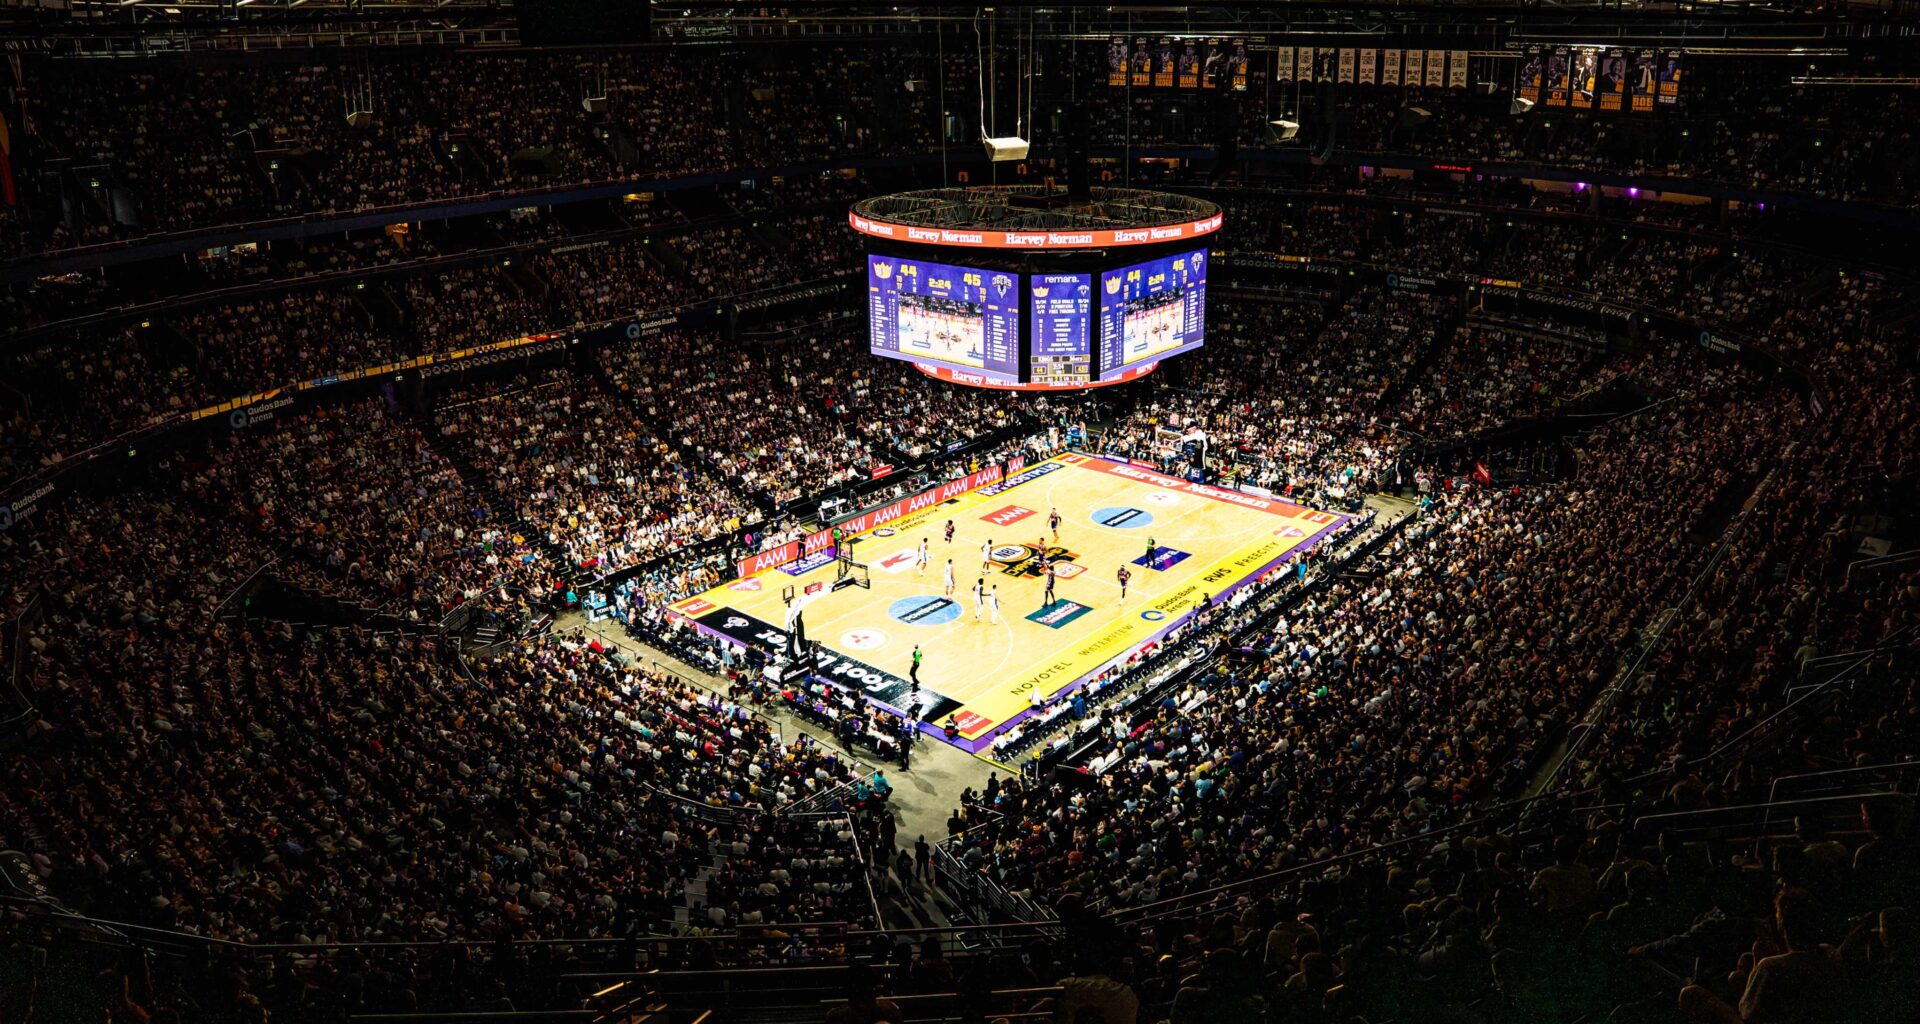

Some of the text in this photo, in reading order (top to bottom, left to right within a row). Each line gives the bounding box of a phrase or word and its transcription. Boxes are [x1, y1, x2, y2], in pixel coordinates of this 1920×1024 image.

[908, 227, 983, 243] Harvey Norman
[1005, 233, 1093, 246] Harvey Norman
[1114, 227, 1182, 243] Harvey Norman
[900, 264, 917, 277] 44
[1173, 259, 1185, 271] 45
[928, 278, 952, 290] 2:24
[963, 273, 982, 288] 45
[1127, 269, 1140, 283] 44
[247, 396, 294, 415] Qudos Bank
[250, 411, 273, 424] Arena
[974, 465, 998, 488] AAMI
[942, 476, 968, 500] AAMI
[1108, 465, 1271, 509] Harvey Norman
[909, 491, 936, 513] AAMI
[873, 503, 901, 527] AAMI
[992, 507, 1029, 525] AAMI
[754, 546, 787, 571] AAMI
[994, 547, 1020, 558] NBL
[1203, 567, 1231, 583] RWS
[832, 661, 895, 693] Foot
[1010, 660, 1073, 696] NOVOTEL
